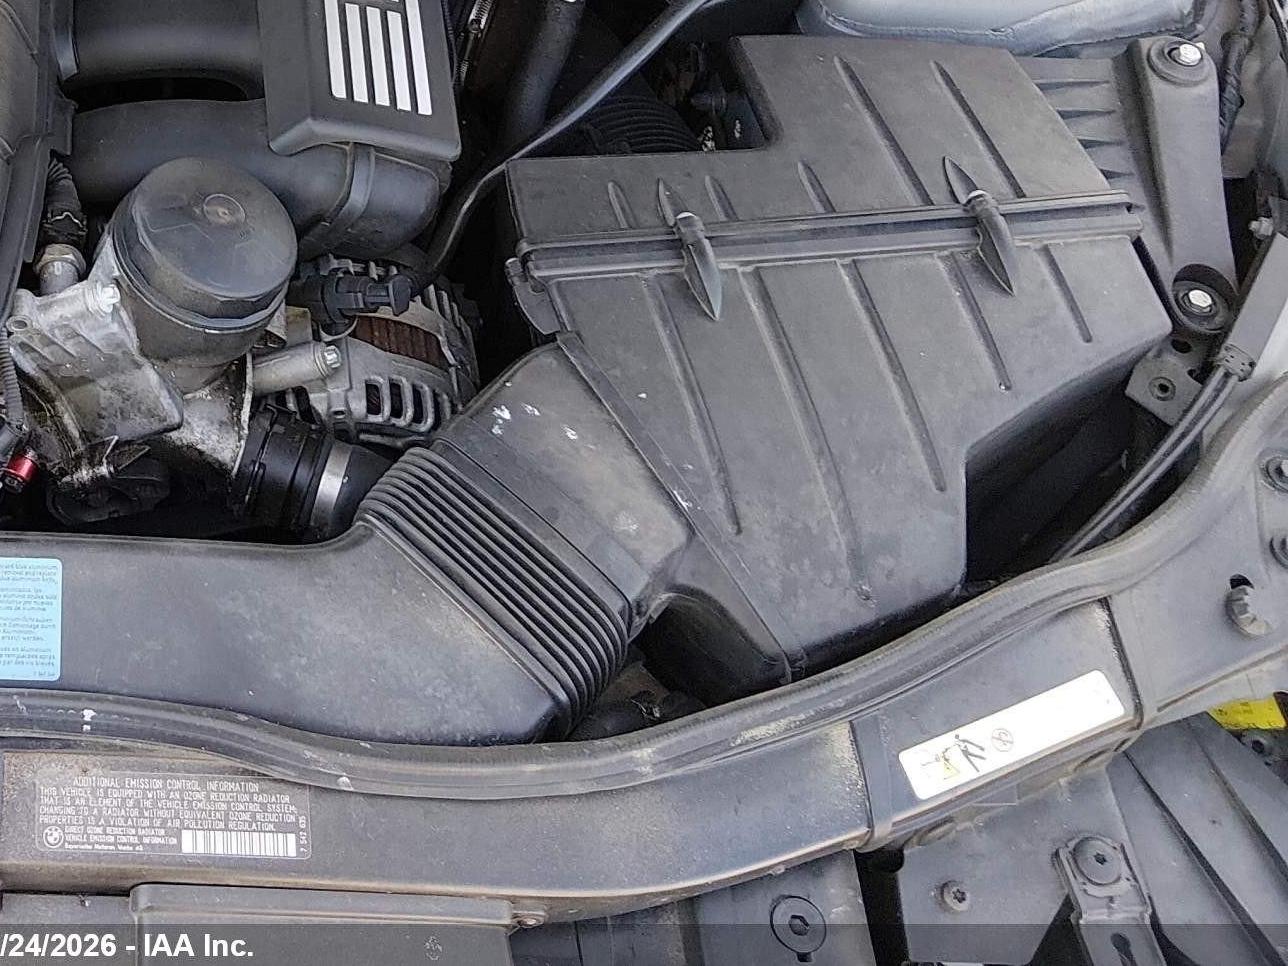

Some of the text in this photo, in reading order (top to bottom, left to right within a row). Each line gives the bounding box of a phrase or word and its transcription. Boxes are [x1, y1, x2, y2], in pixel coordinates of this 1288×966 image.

[73, 777, 259, 792] ADDITIONAL EMISSION CONTROL INFORMATION
[40, 786, 290, 804] THIS VEHICLE IS EQUIPPED WITH AN OZONE REDUCTION RADIATOR
[40, 796, 59, 805] THAT
[63, 796, 71, 805] IS
[75, 797, 86, 806] AN
[89, 797, 122, 807] ELEMENT
[126, 798, 135, 807] OF
[140, 799, 153, 808] THE
[158, 800, 188, 810] VEHICLE
[192, 801, 227, 811] EMISSION
[231, 802, 262, 812] CONTROL
[40, 805, 296, 823] CHANGING TO A RADIATOR WITHOUT EQUIVALENT OZONE REDUCTION
[39, 815, 276, 831] PROPERTIES IS A VIOLATION OF AIR POLLUTION REGULATION.
[64, 833, 177, 845] VEHICLE EMISSION CONTROL INFORMATION
